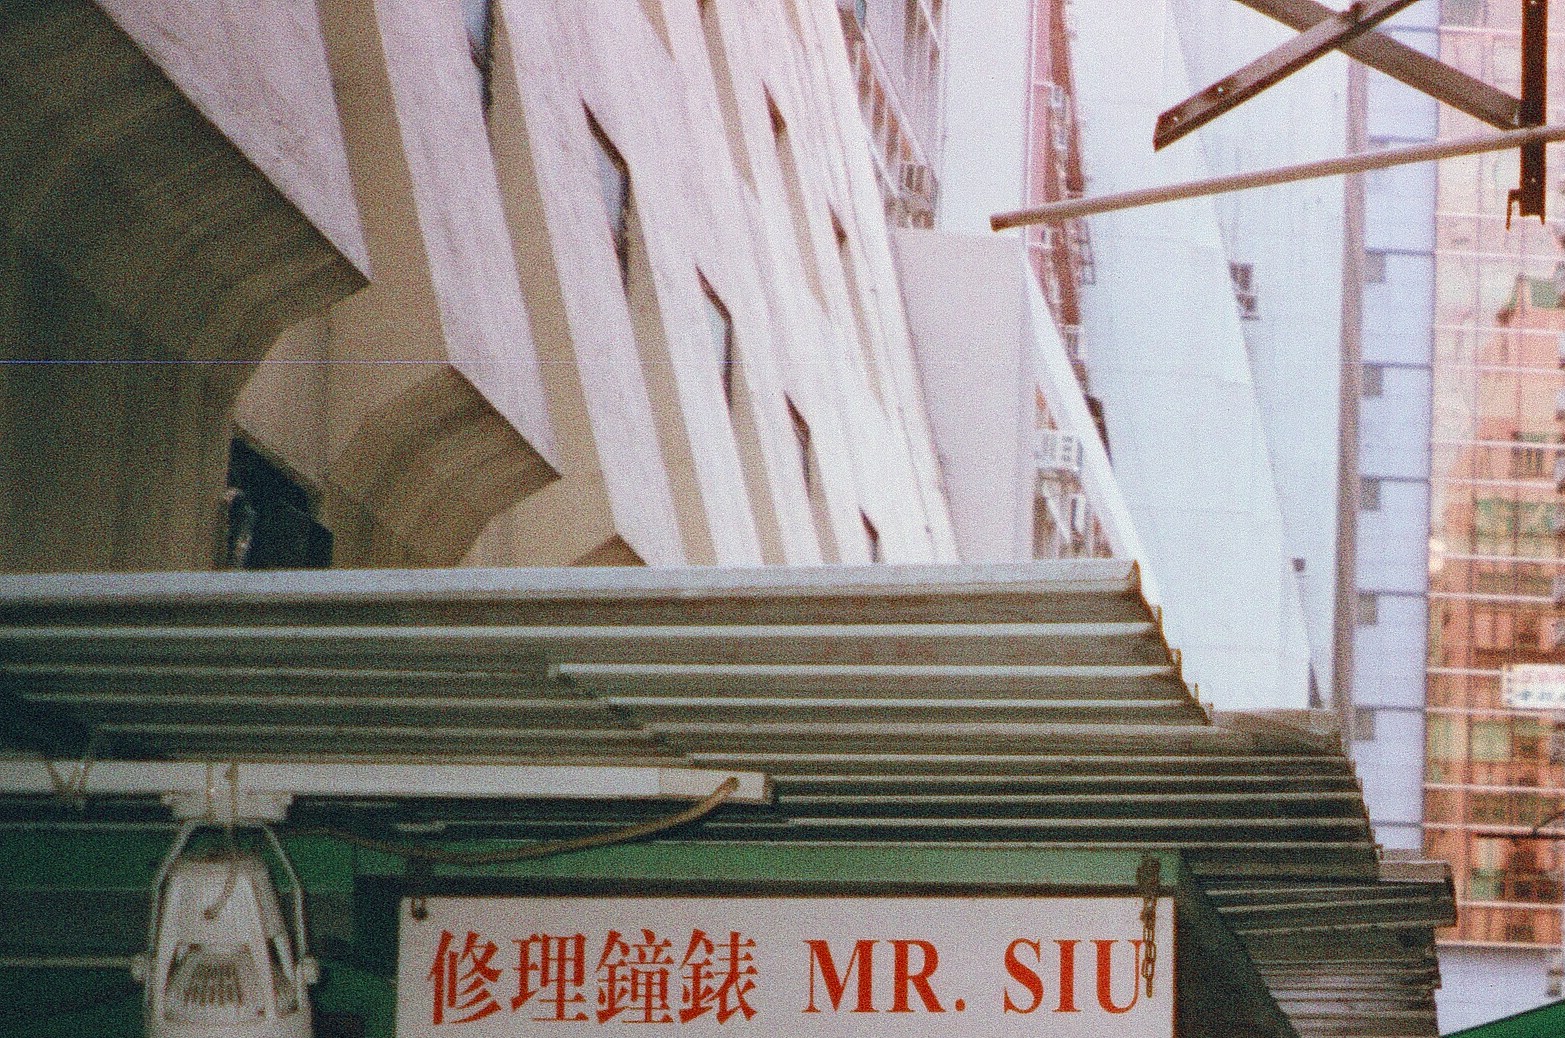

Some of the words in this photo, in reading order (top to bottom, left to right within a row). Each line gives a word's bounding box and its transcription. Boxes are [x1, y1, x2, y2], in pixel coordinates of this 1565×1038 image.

[429, 929, 757, 1026] 修理鐘錶
[804, 939, 967, 1014] MR.
[1003, 938, 1150, 1015] SIU
